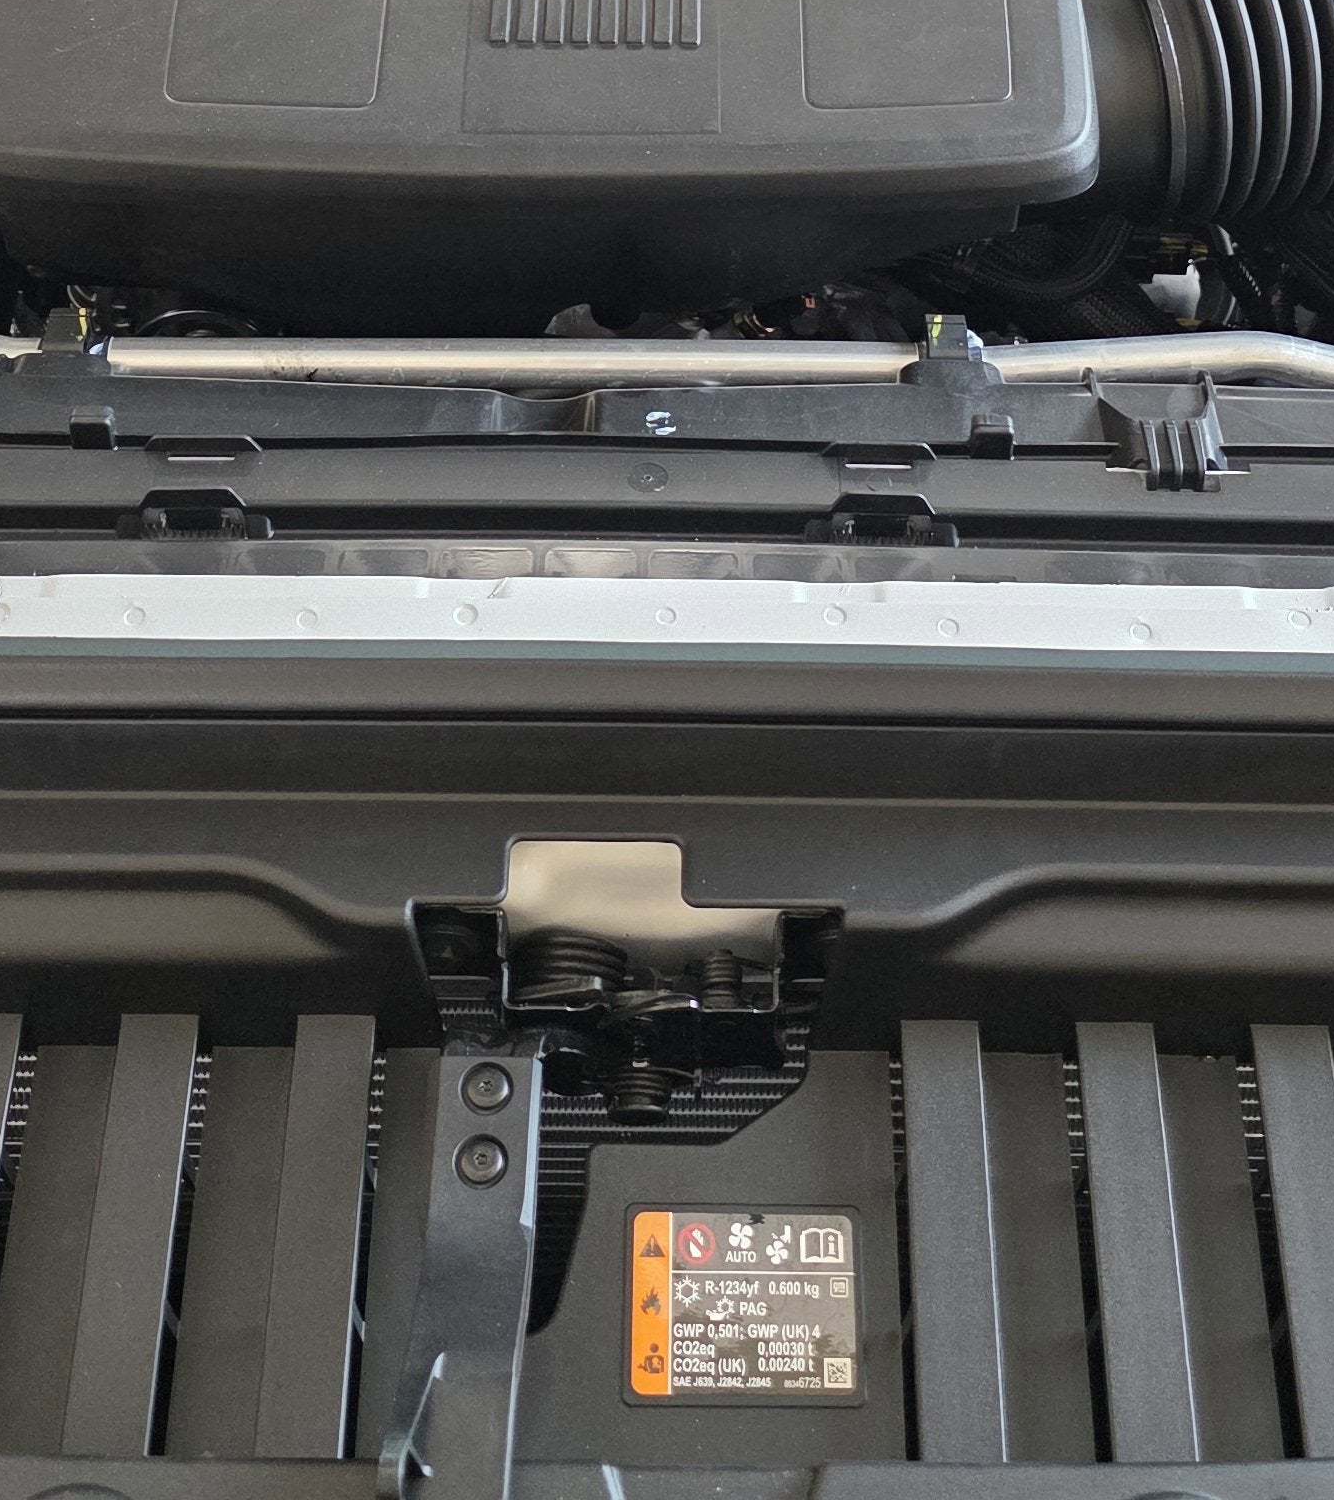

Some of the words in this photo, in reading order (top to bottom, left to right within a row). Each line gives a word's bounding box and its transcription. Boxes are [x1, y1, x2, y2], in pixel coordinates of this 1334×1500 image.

[725, 1250, 757, 1263] AUTO
[705, 1280, 760, 1298] R-1234yf
[768, 1280, 801, 1295] 0.600
[804, 1281, 820, 1299] kg
[739, 1301, 767, 1316] PAG
[673, 1323, 705, 1338] GWP
[707, 1323, 744, 1340] 0,501;
[747, 1323, 779, 1339] GWP
[782, 1324, 810, 1341] (UK)
[812, 1324, 821, 1339] 4
[673, 1340, 715, 1358] CO2eq
[757, 1341, 805, 1357] 0,00030
[808, 1342, 816, 1356] t
[673, 1357, 715, 1375] CO2eq
[718, 1357, 746, 1376] (UK)
[757, 1357, 806, 1372] 0.00240
[808, 1358, 816, 1372] t
[673, 1376, 692, 1387] SAE
[693, 1376, 715, 1388] J639,
[746, 1376, 772, 1387] J2845
